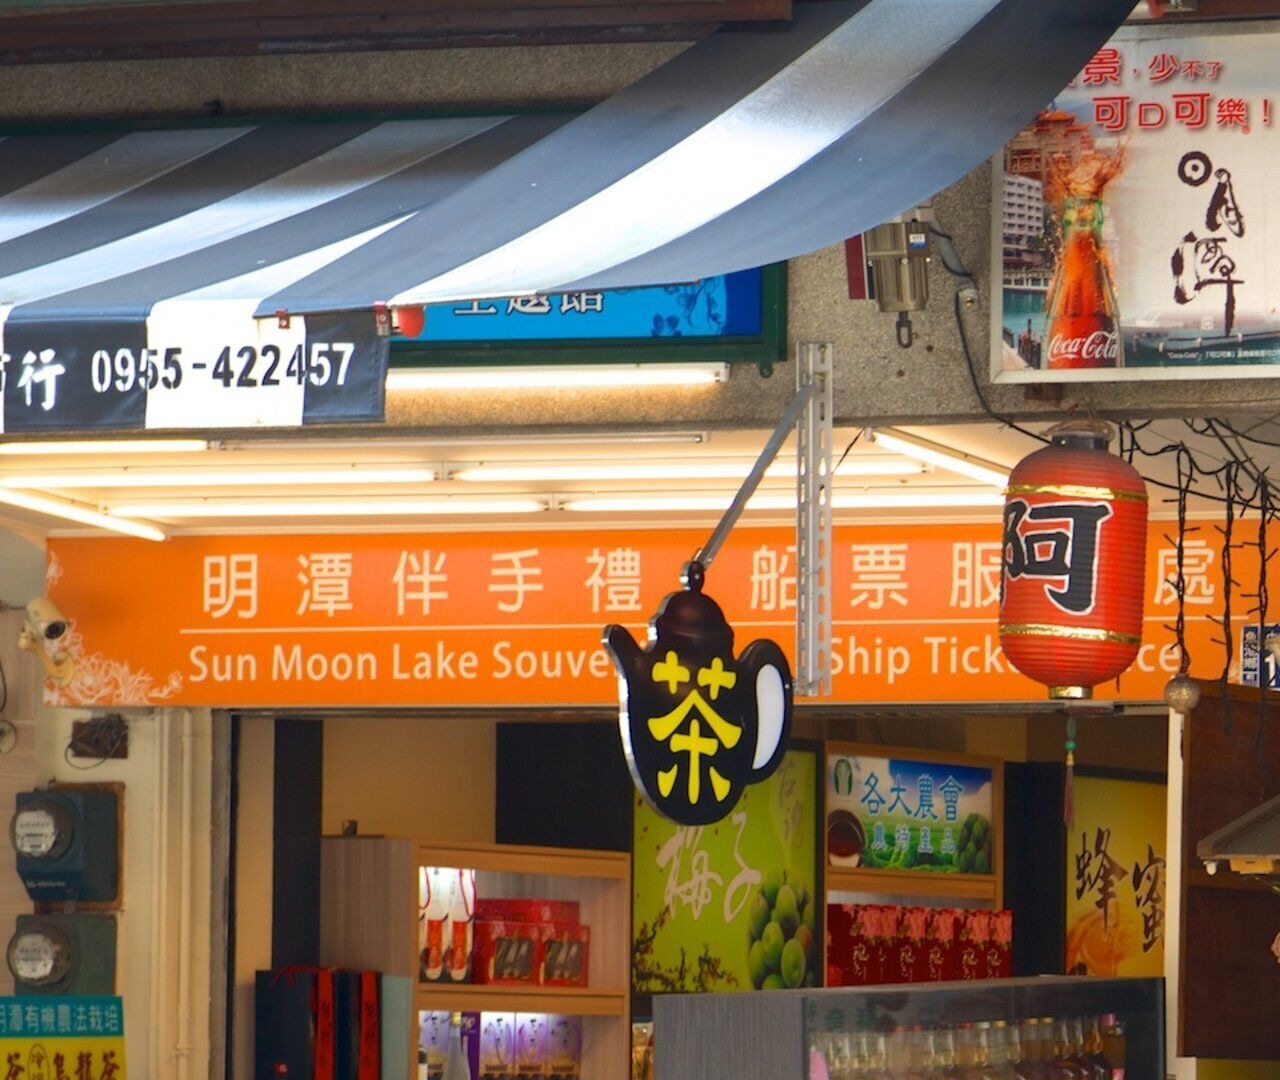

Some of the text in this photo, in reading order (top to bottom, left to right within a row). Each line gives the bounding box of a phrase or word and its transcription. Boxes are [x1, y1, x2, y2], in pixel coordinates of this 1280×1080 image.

[91, 342, 354, 394] 0955-422457
[1048, 331, 1119, 362] Coca-Cola
[202, 540, 1216, 618] 明潭伴手禮 船票服處
[999, 497, 1114, 617] 阿
[188, 645, 257, 683] Sun
[270, 643, 378, 682] Moon
[392, 641, 479, 681] Lake
[923, 635, 1013, 677] Tick
[648, 651, 742, 805] 茶
[861, 770, 966, 822] 各大農會
